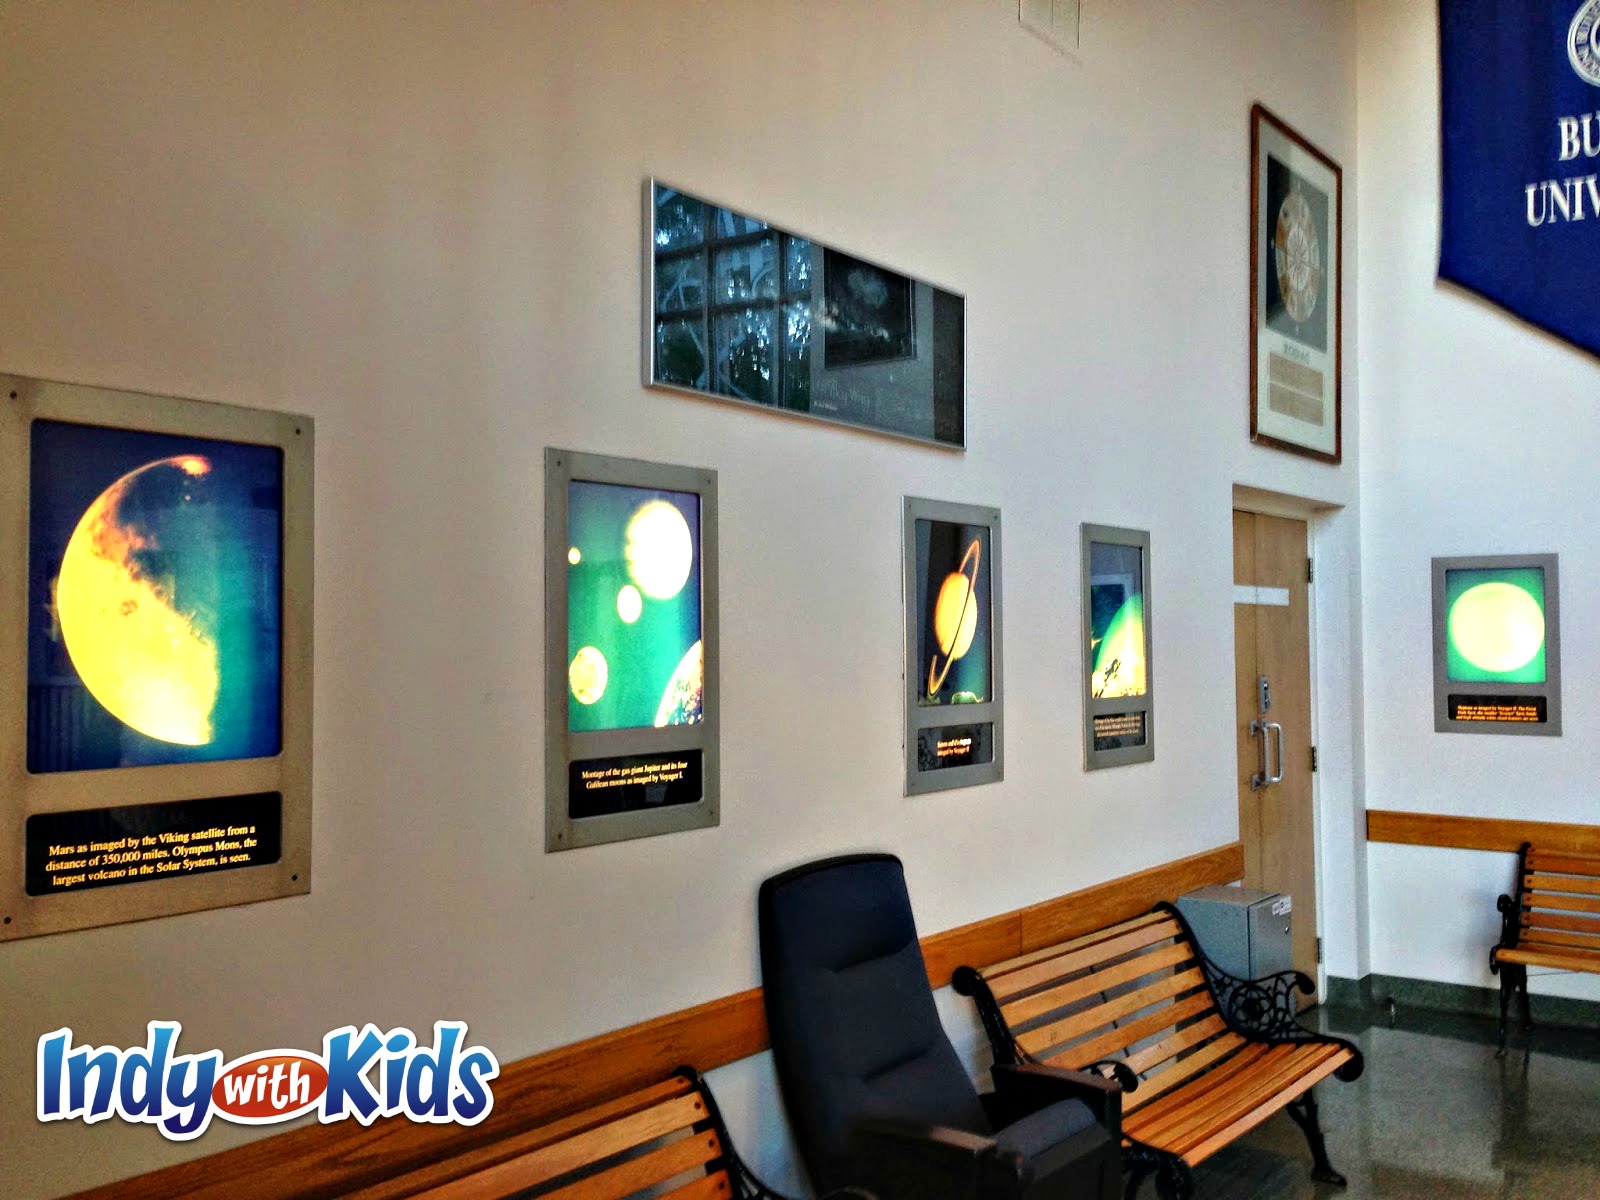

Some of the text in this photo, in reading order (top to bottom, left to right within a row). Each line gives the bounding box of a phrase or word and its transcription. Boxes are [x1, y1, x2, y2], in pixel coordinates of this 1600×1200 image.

[581, 771, 605, 779] Montage
[621, 768, 631, 776] gas
[631, 766, 644, 775] giant
[644, 764, 661, 773] Jupiter
[661, 763, 671, 771] and
[586, 781, 609, 789] Galilean
[633, 775, 652, 784] imaged
[652, 774, 659, 783] by
[659, 773, 679, 782] Voyager
[45, 838, 258, 871] distance of 350,000 miles. Olympus Mons, the
[48, 845, 75, 856] Mars
[77, 845, 88, 853] as
[90, 838, 126, 852] imaged
[127, 838, 140, 849] by
[142, 836, 157, 845] the
[158, 833, 190, 843] Viking
[191, 828, 226, 840] satellite
[227, 826, 249, 836] from
[52, 854, 251, 886] largest volcano in the Solar System, is seen.
